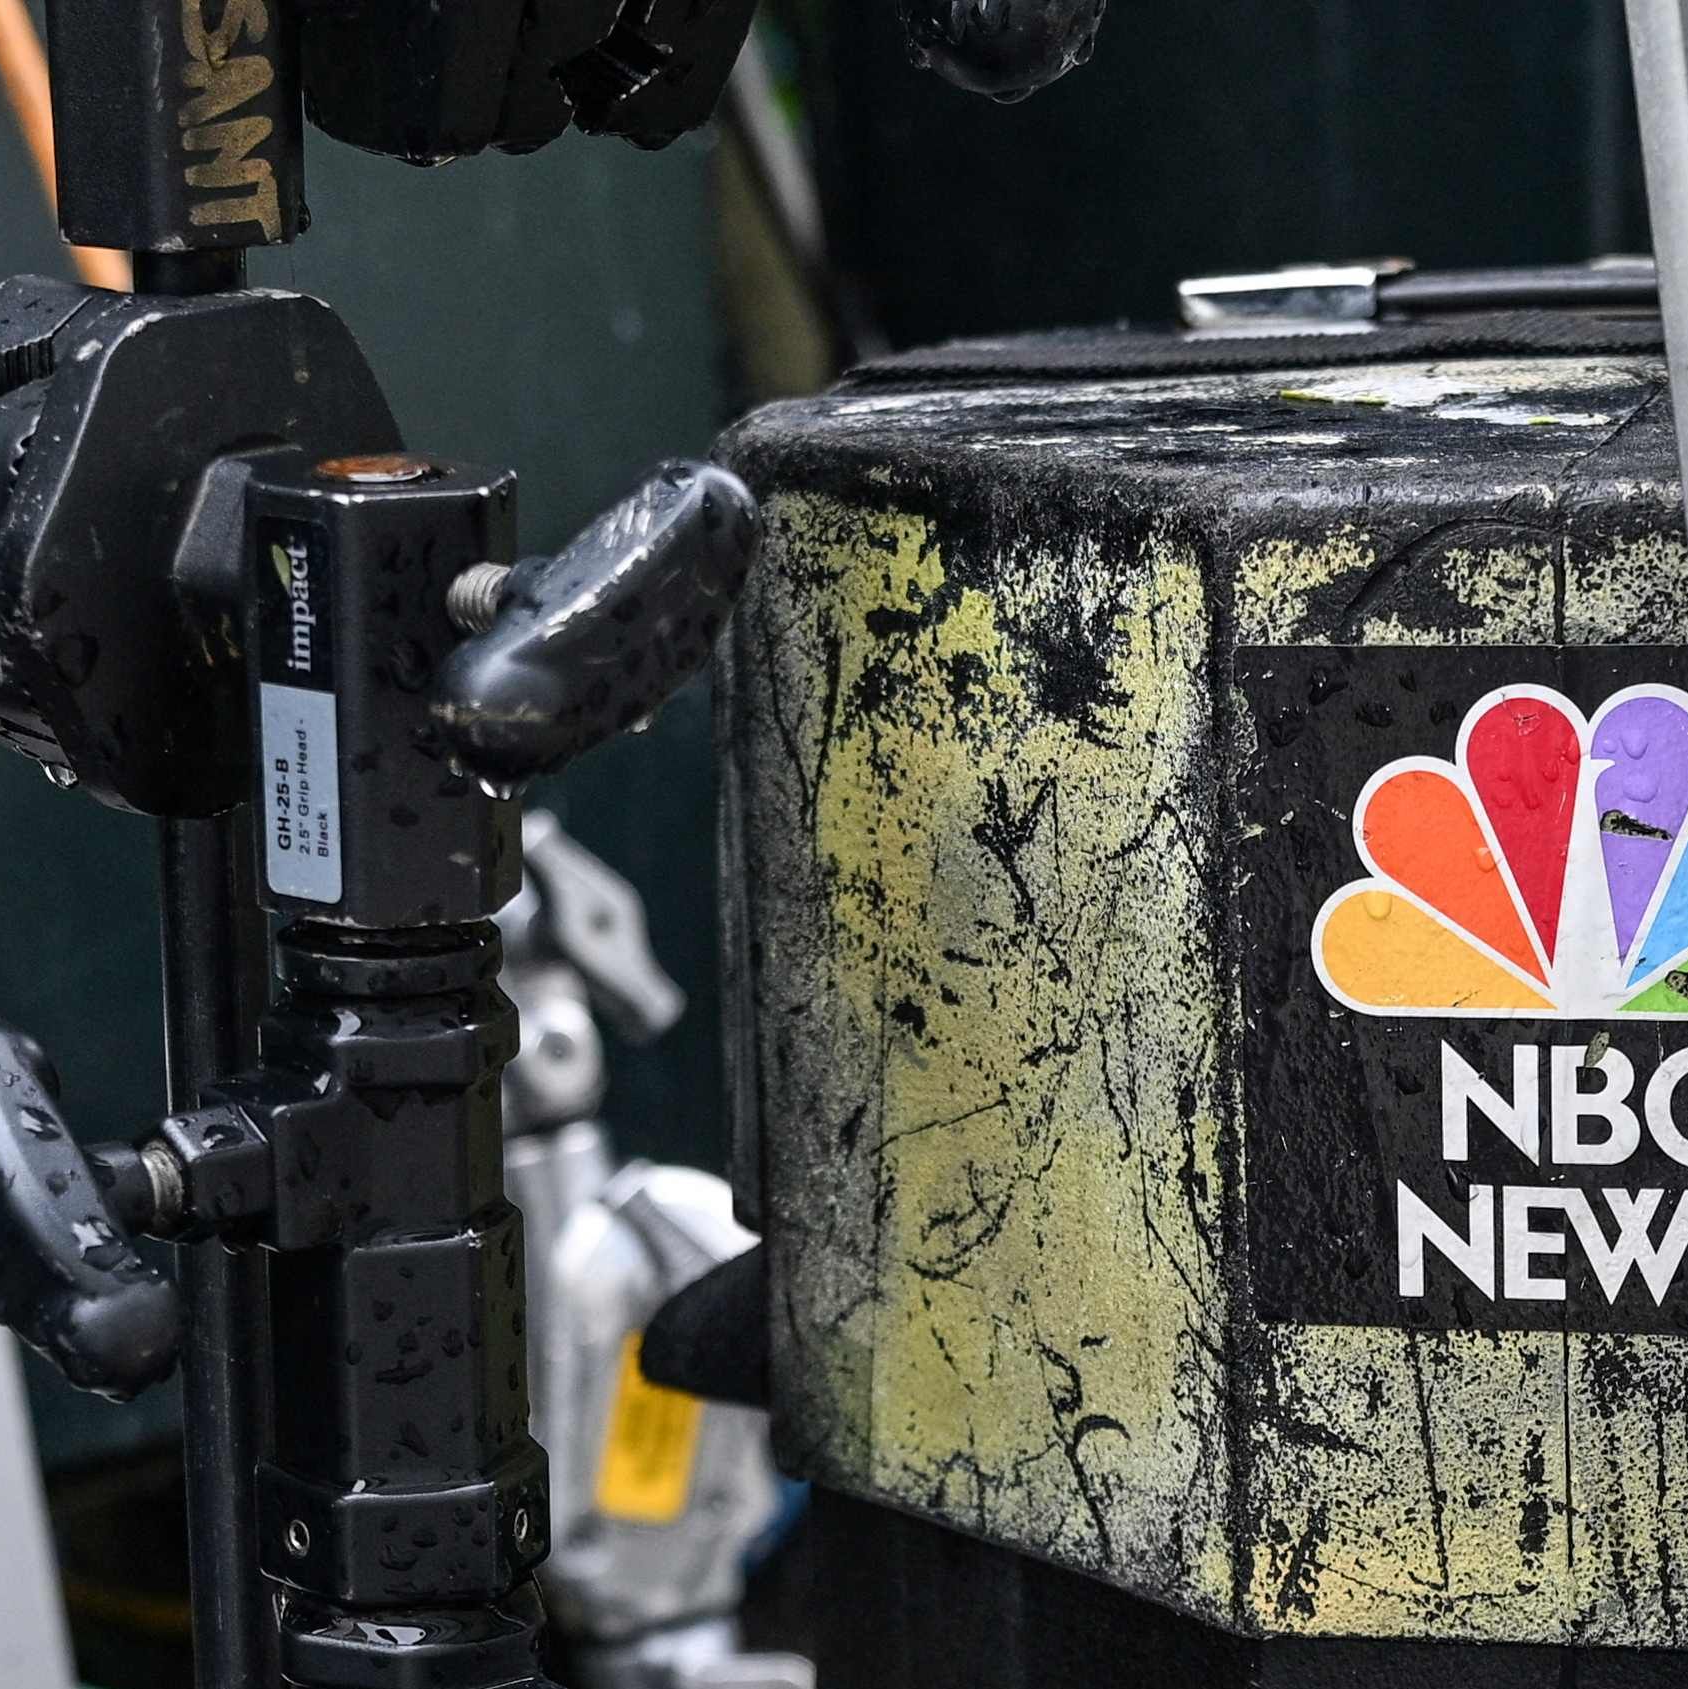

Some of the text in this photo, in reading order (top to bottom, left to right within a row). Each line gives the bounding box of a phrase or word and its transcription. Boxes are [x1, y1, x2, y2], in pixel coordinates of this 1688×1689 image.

[285, 544, 317, 672] impact
[295, 729, 308, 775] Head
[276, 758, 292, 851] GH-25-B
[298, 780, 311, 817] Grip
[317, 812, 330, 858] Black
